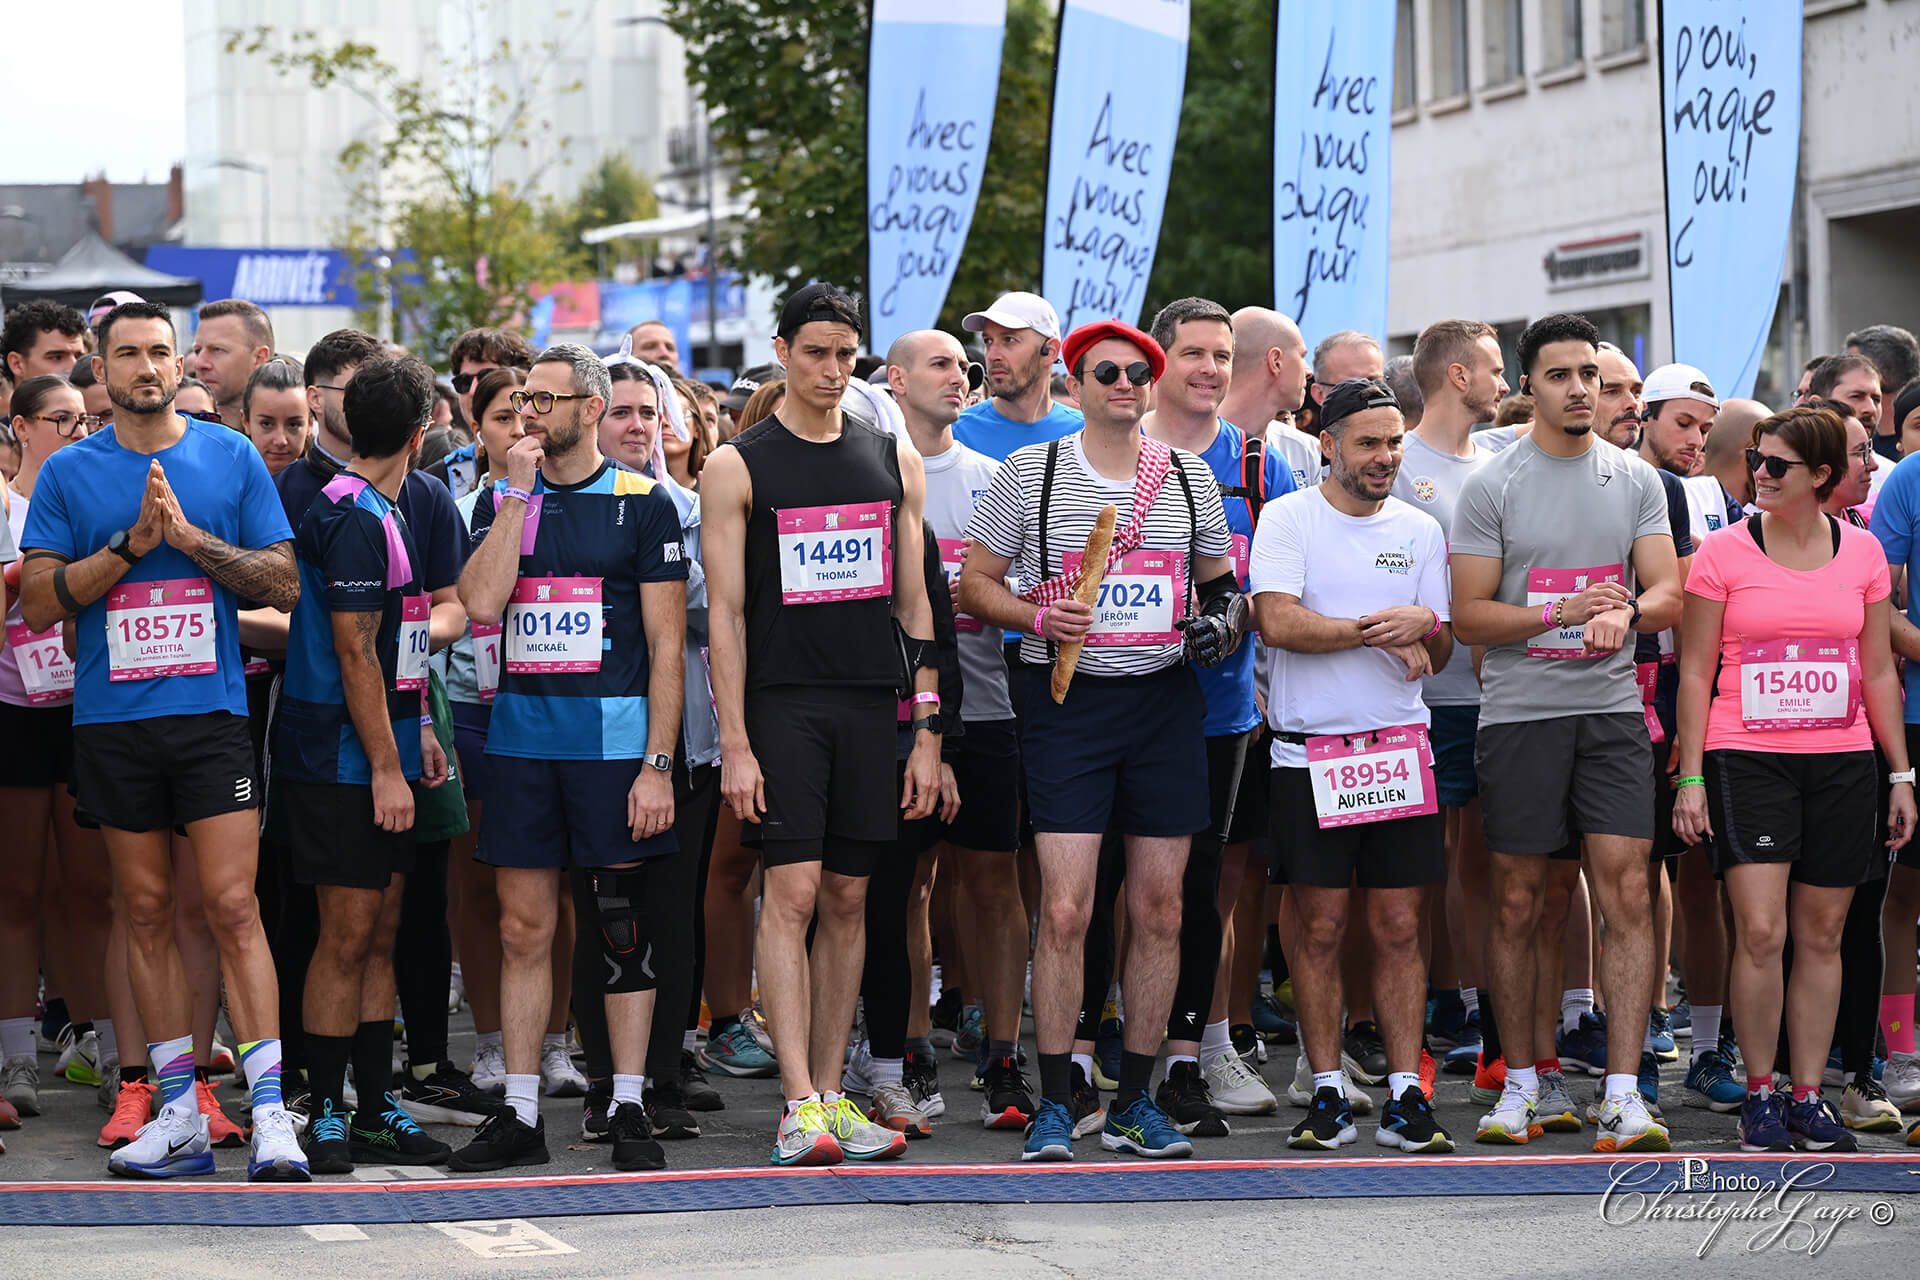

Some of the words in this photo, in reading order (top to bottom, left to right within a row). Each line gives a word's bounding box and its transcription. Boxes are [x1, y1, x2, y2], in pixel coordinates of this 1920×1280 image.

[907, 86, 977, 151] Avec
[1085, 91, 1151, 176] Avec
[231, 250, 330, 303] ARRIVÉE
[793, 537, 872, 566] 14491
[816, 570, 858, 581] THOMAS
[1096, 583, 1163, 608] 7024
[118, 612, 205, 643] 18575
[513, 611, 591, 636] 10149
[1100, 609, 1139, 623] JÉRÔME
[140, 643, 184, 656] LAETITIA
[409, 630, 428, 653] 10
[526, 641, 568, 652] MICKAËL
[29, 645, 75, 671] 12
[1753, 670, 1837, 694] 15400
[1779, 698, 1811, 707] EMILIE
[1323, 758, 1410, 791] 18954
[1337, 786, 1406, 810] AURELIEN
